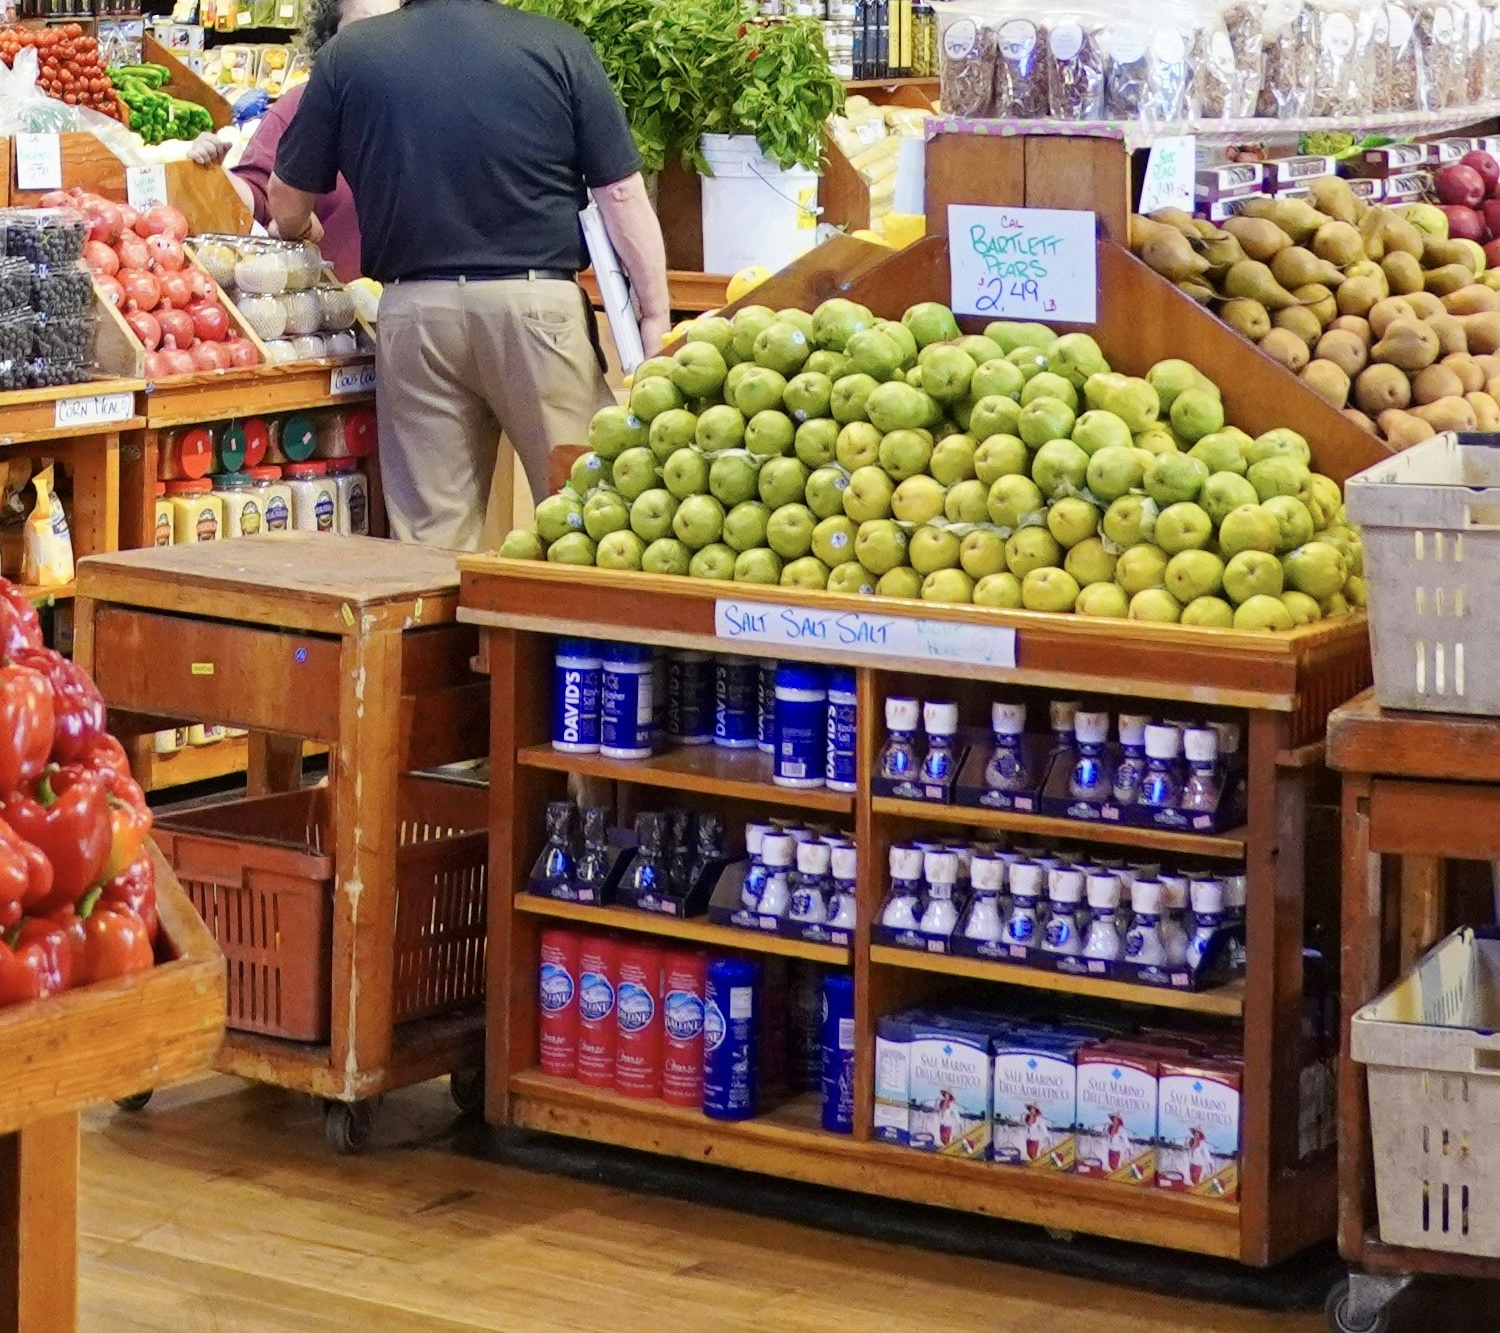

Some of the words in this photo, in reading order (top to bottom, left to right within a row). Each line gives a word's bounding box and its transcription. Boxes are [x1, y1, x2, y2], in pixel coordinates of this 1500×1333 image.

[1000, 215, 1025, 229] CAL
[970, 224, 1064, 256] BARTLETT
[983, 253, 1048, 280] PEARS
[1043, 298, 1057, 312] LB
[58, 399, 89, 421] CORN
[724, 604, 770, 636] SALT
[779, 608, 835, 640] SALT
[835, 612, 897, 645] SALT
[563, 671, 581, 743] DAVID'S
[715, 666, 727, 737] DAVID'S
[826, 705, 837, 779] DAVID'S
[919, 1054, 940, 1068] SALE
[941, 1059, 976, 1073] MARINO
[1003, 1070, 1024, 1085] SALE
[1025, 1071, 1064, 1087] MARINO
[1088, 1077, 1106, 1091] SALE
[1107, 1079, 1146, 1099] MARINO
[1169, 1091, 1189, 1104] SALE
[1190, 1094, 1227, 1112] MARINO
